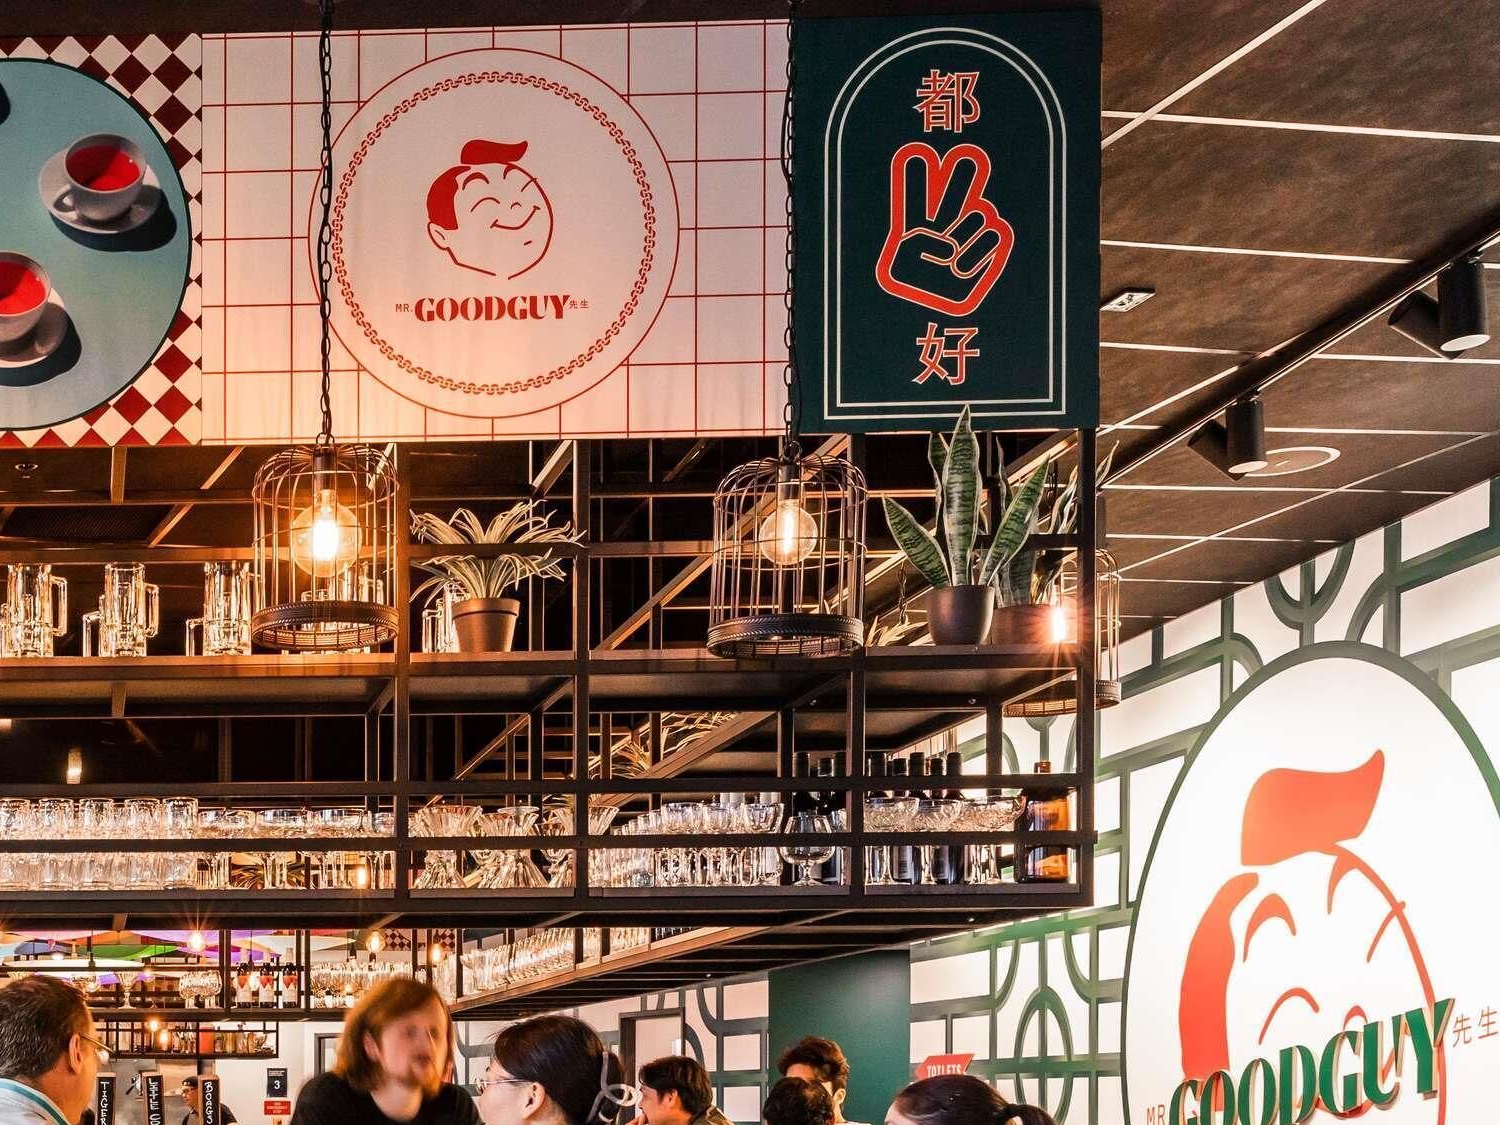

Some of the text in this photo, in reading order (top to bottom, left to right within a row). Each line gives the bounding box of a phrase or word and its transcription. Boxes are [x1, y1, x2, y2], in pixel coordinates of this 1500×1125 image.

[911, 69, 981, 386] 都 好
[395, 294, 589, 322] MR. GOODGUY 先生
[1452, 1005, 1499, 1048] 先生
[273, 1079, 281, 1090] 3
